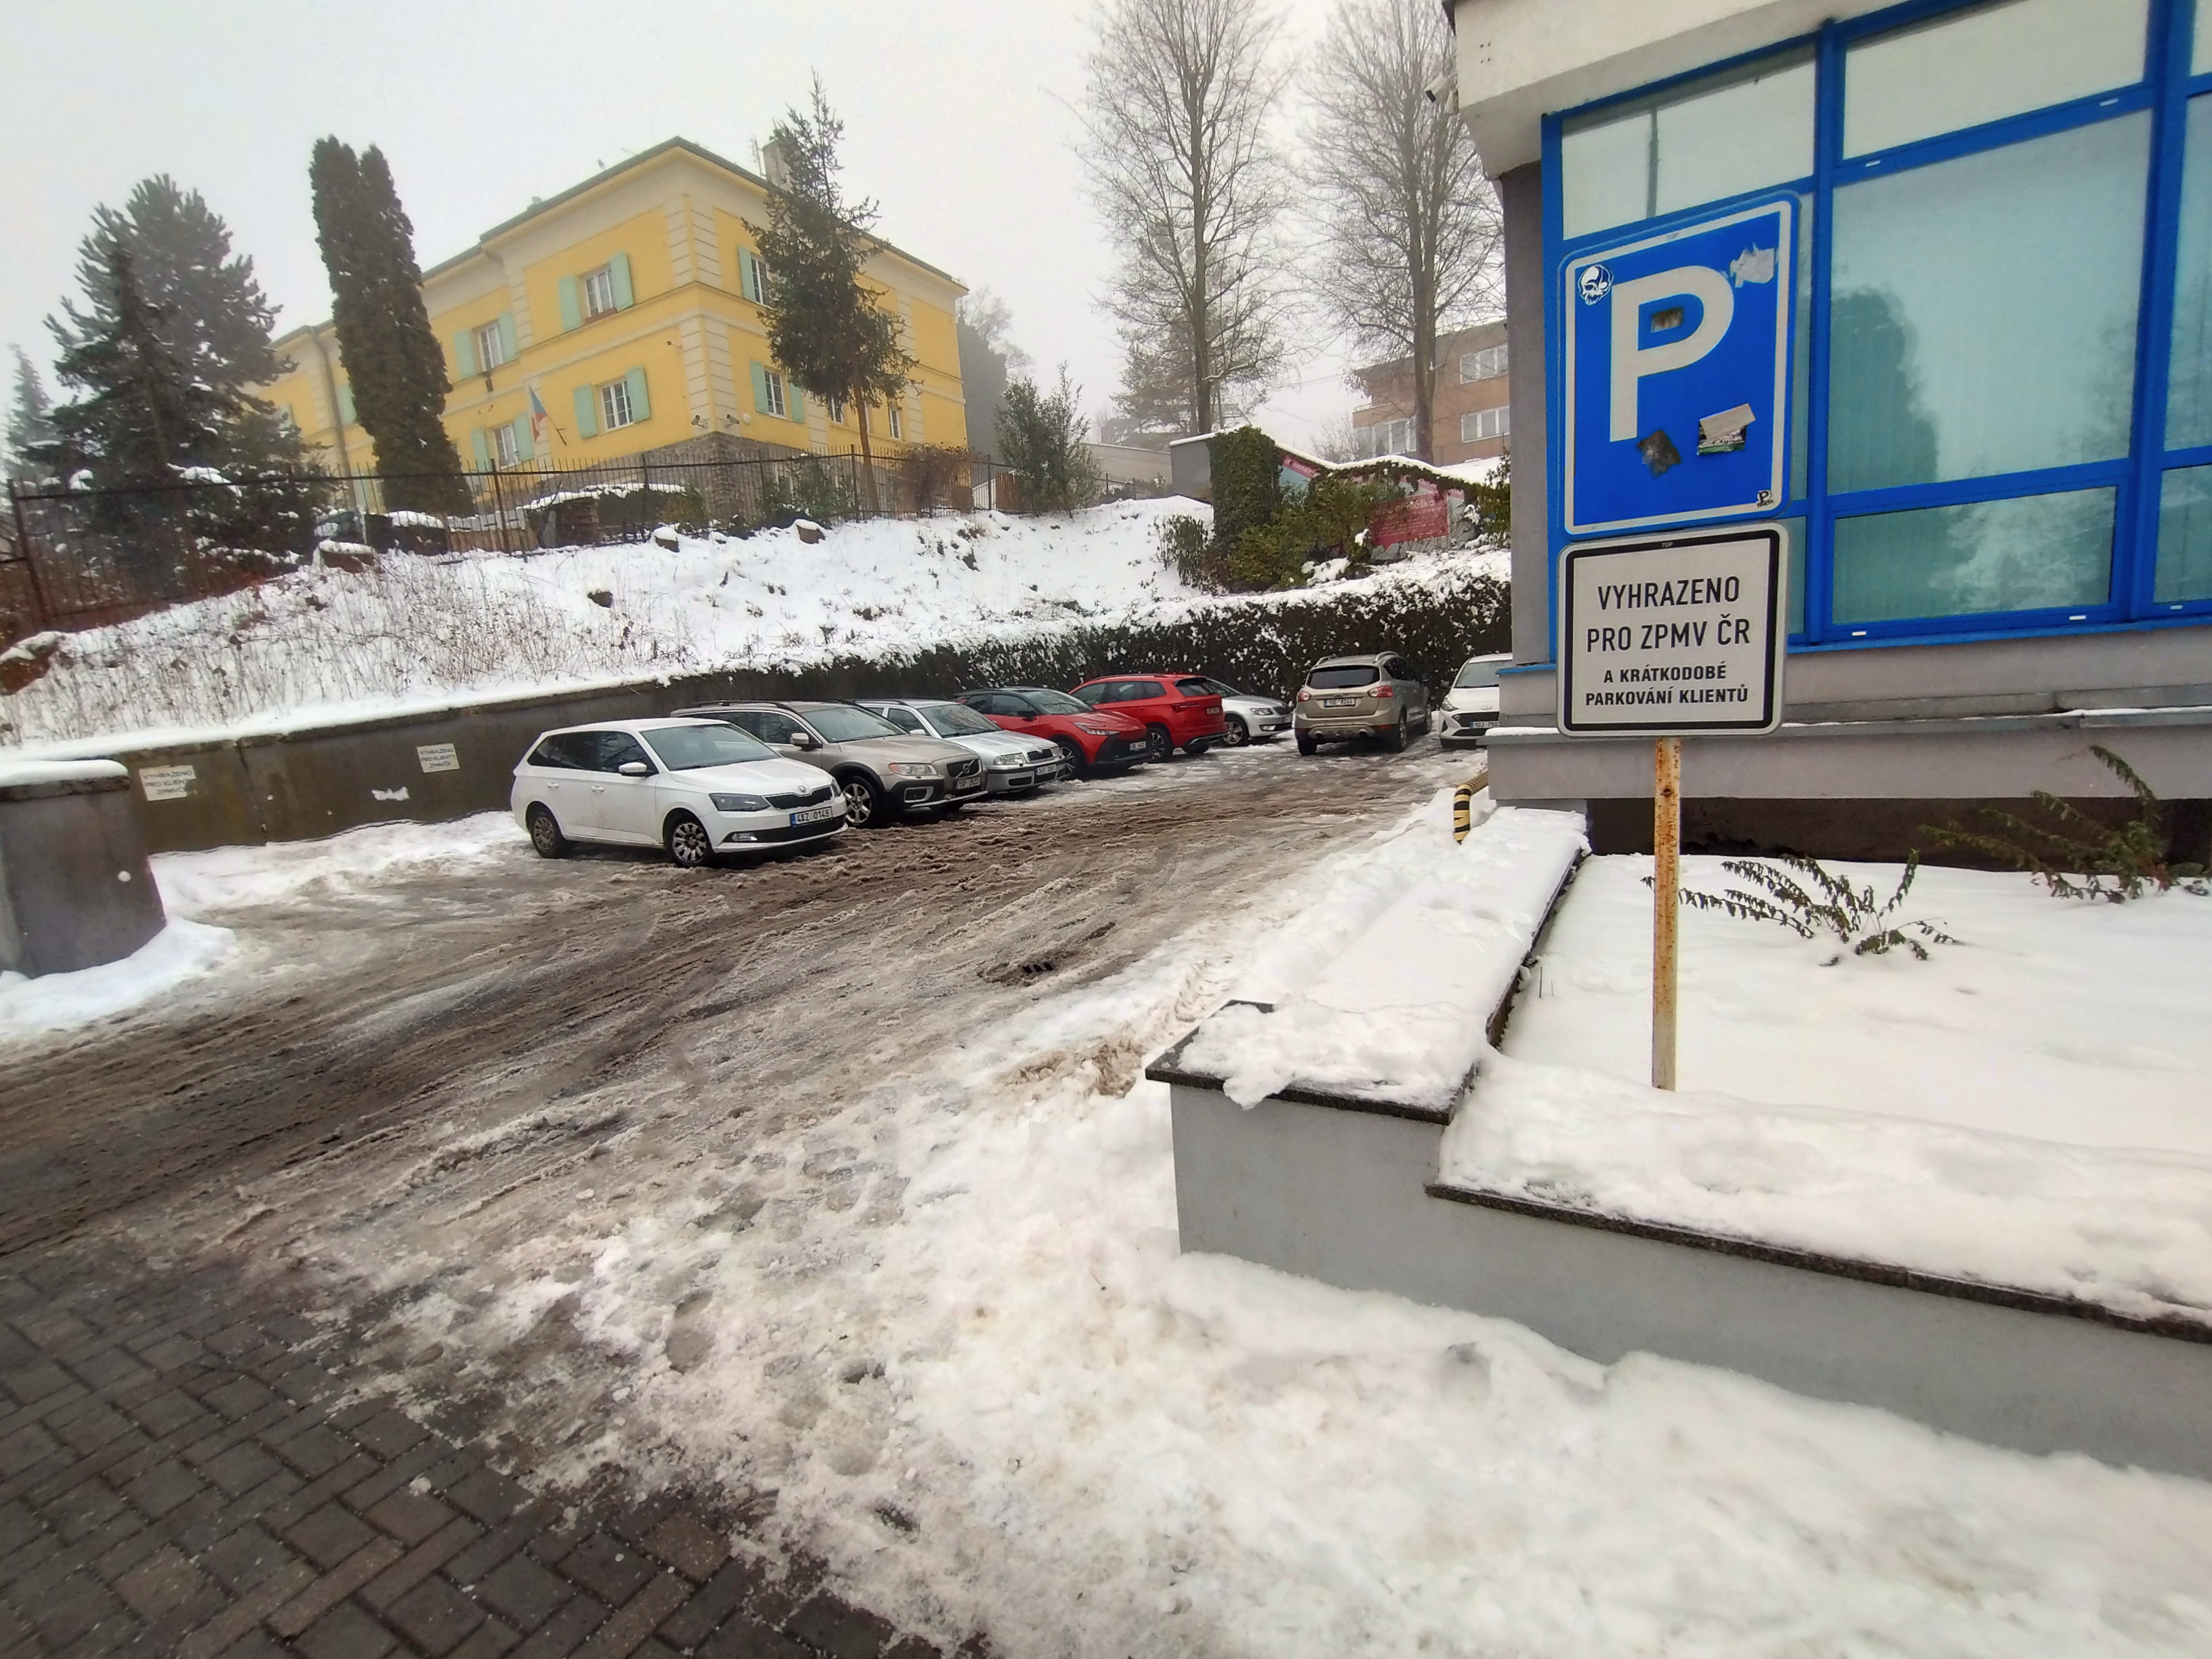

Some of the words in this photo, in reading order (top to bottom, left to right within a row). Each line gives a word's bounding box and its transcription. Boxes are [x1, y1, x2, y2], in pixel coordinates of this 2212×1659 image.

[1609, 265, 1734, 442] P
[1597, 576, 1740, 610] VYHRAZENO
[1587, 626, 1631, 652] PRO
[1641, 621, 1708, 650] ZPMV
[1718, 613, 1750, 645] ČR
[1603, 670, 1614, 683] A
[1620, 661, 1727, 683] KRÁTKODOBÉ
[1586, 686, 1674, 705] PARKOVÁNÍ
[1679, 684, 1748, 703] KLIENTŮ
[797, 813, 810, 822] 4AZ
[813, 809, 830, 819] 0149
